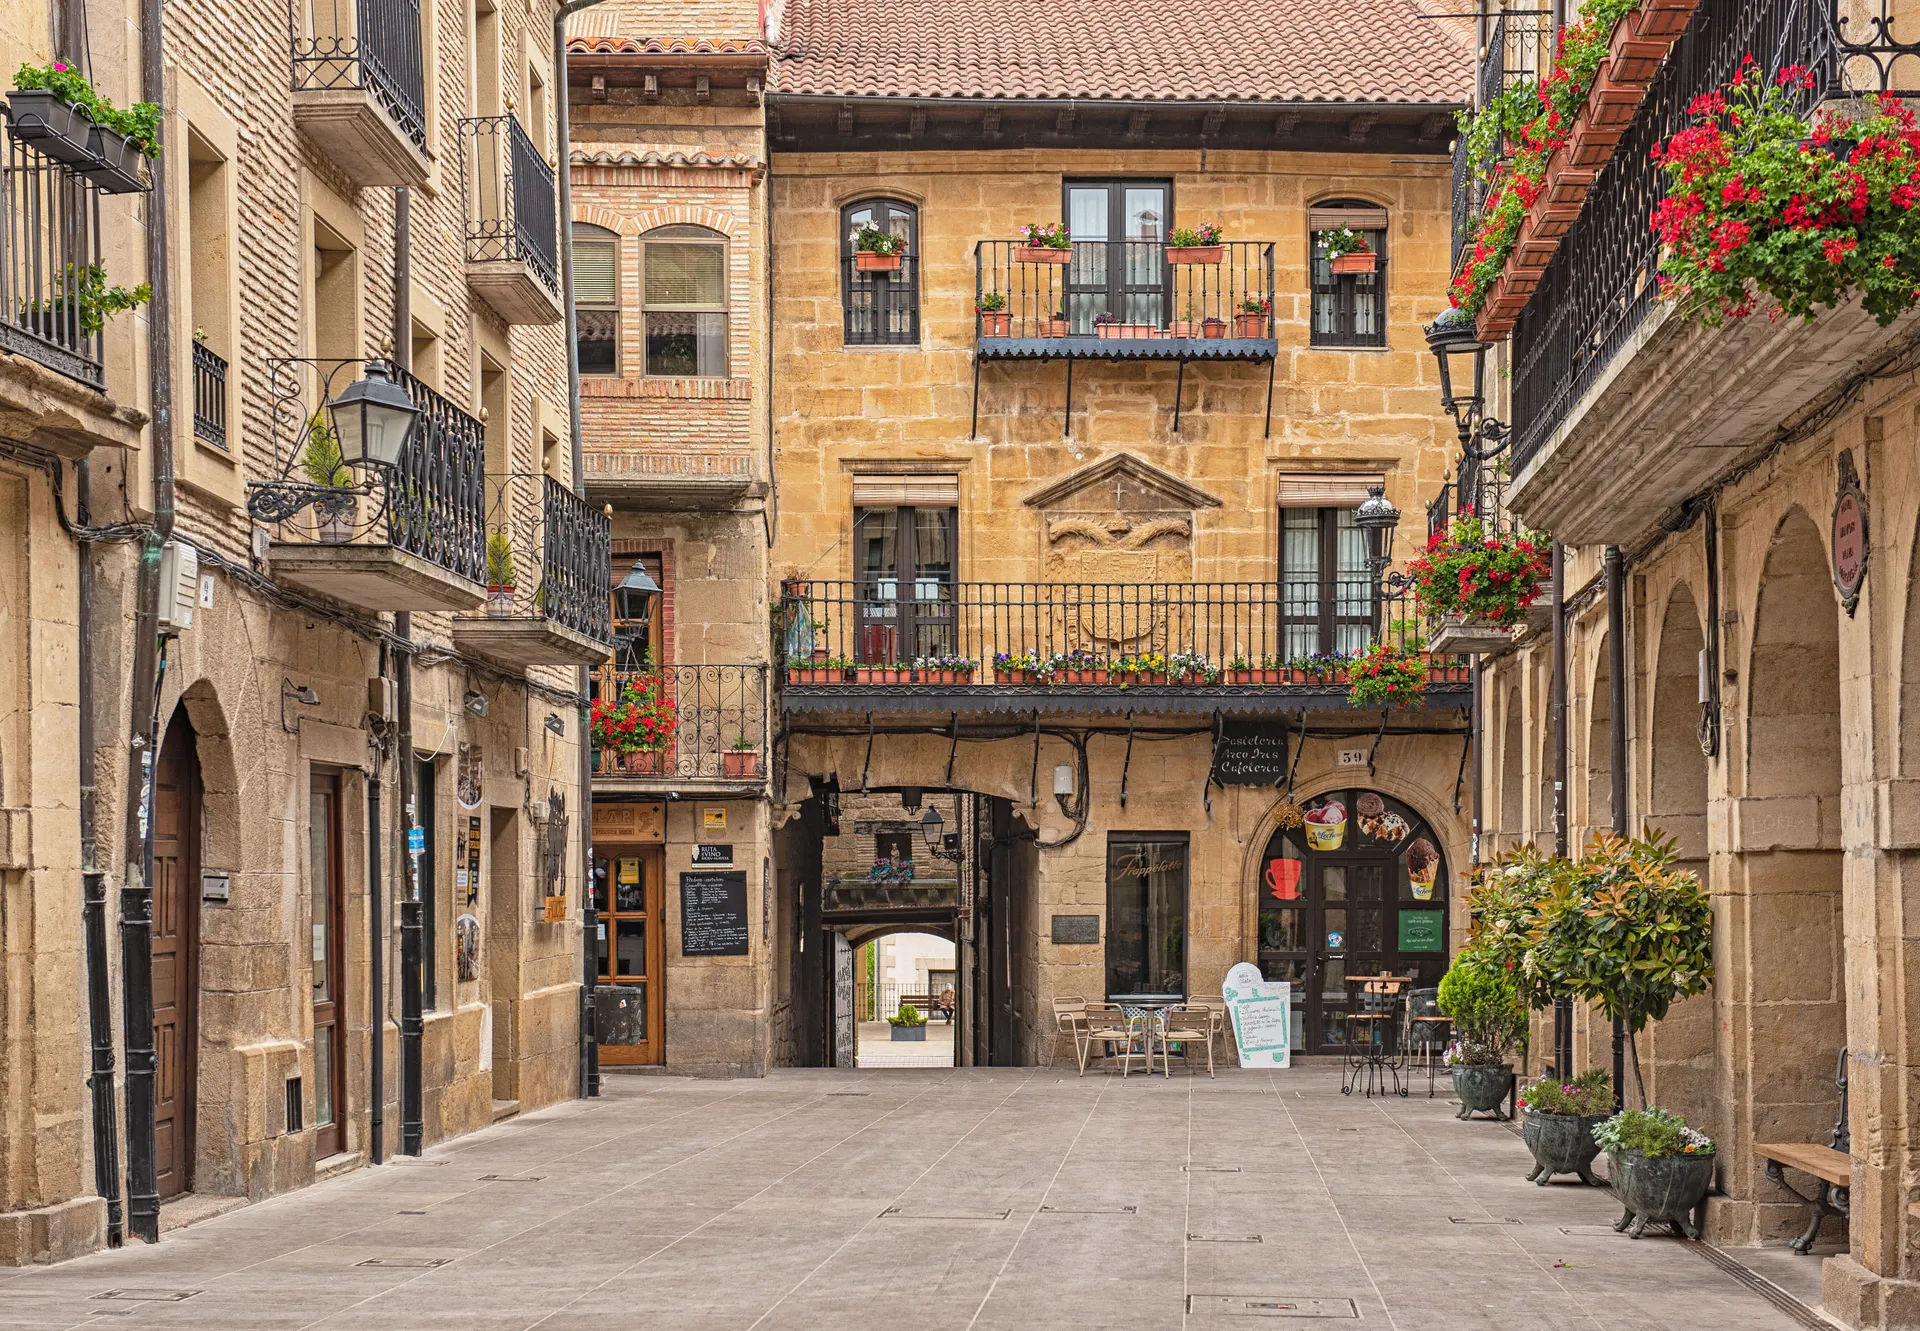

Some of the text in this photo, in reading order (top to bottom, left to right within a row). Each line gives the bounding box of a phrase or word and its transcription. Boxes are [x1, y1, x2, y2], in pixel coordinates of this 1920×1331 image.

[1220, 747, 1279, 759] Arco Iris
[1343, 752, 1362, 763] 39
